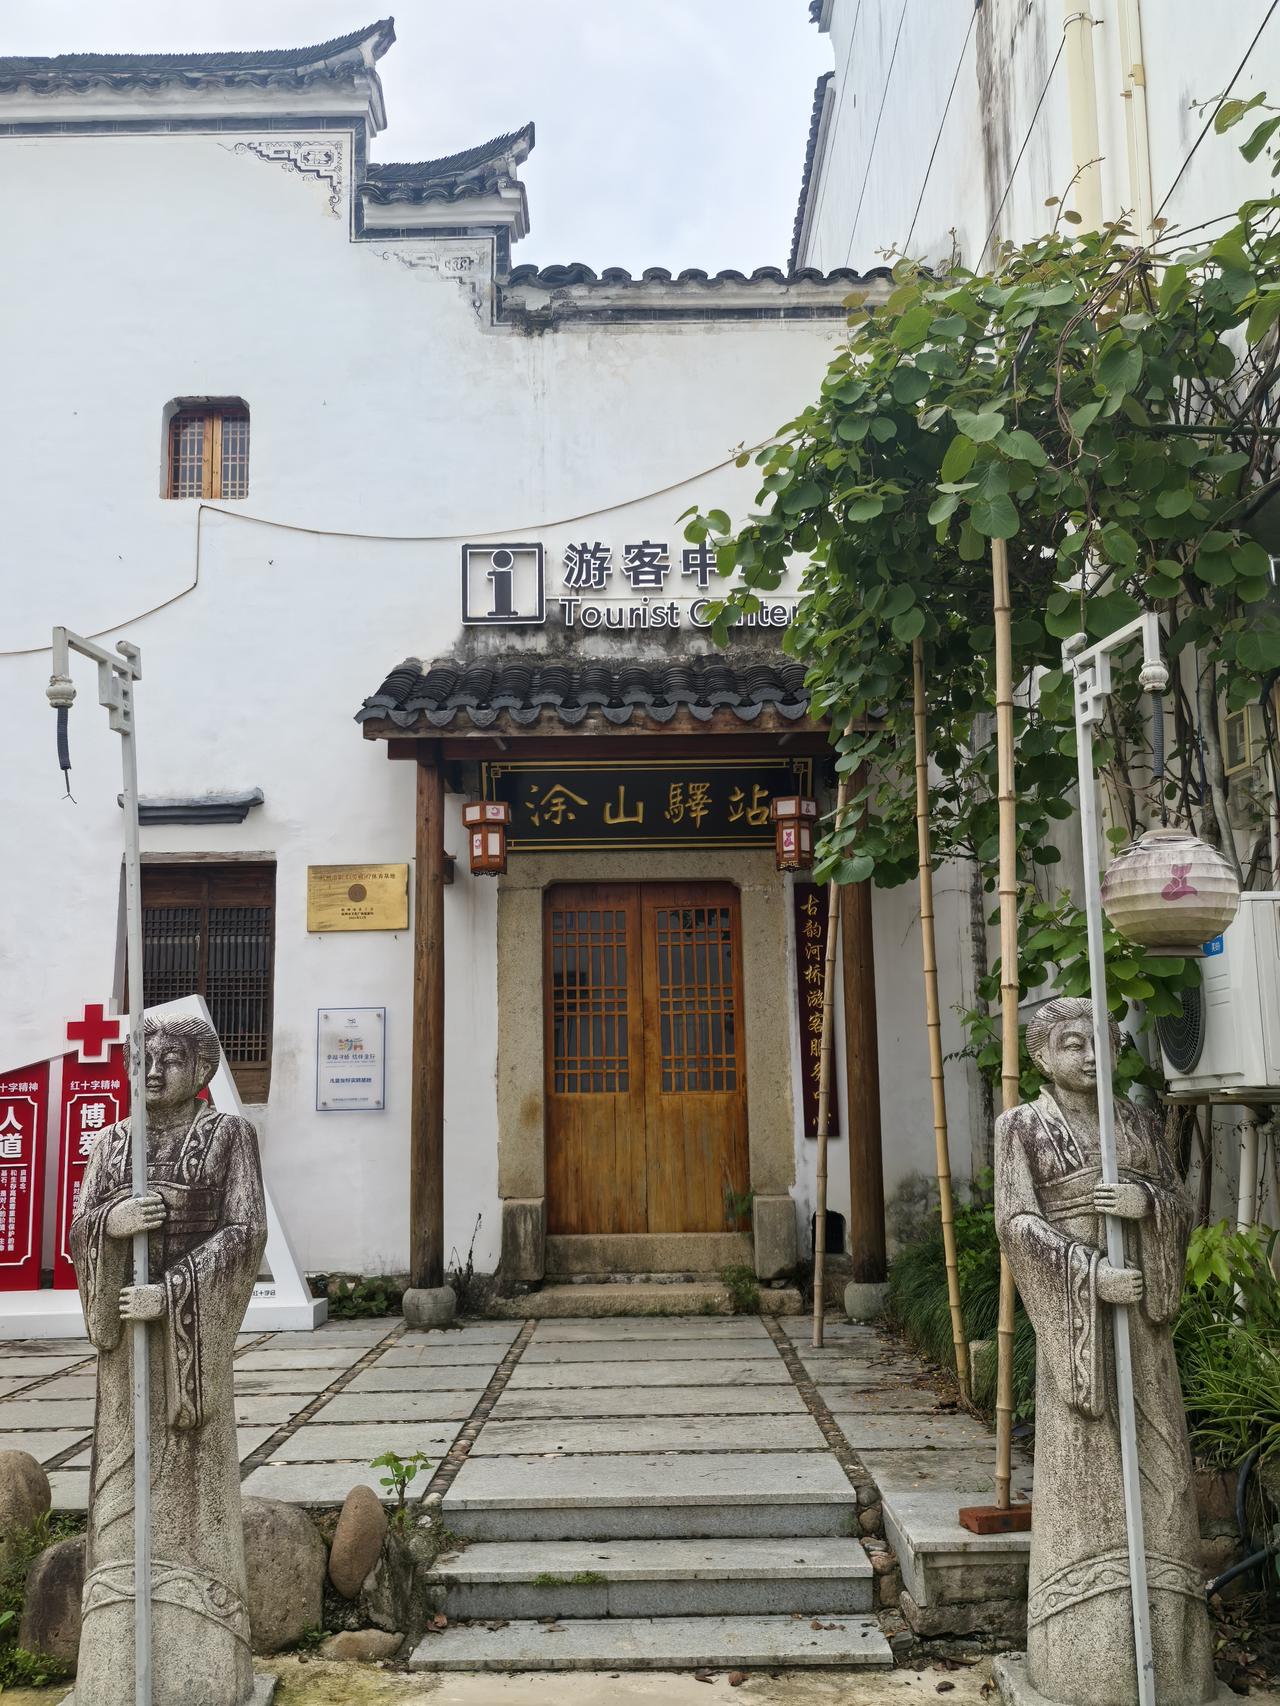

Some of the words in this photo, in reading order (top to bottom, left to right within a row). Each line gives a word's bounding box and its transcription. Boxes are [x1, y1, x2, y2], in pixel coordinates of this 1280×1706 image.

[563, 540, 790, 588] 游客中
[559, 595, 681, 628] Tourist
[70, 1079, 121, 1091] 红十字精神
[0, 1105, 23, 1158] 人道
